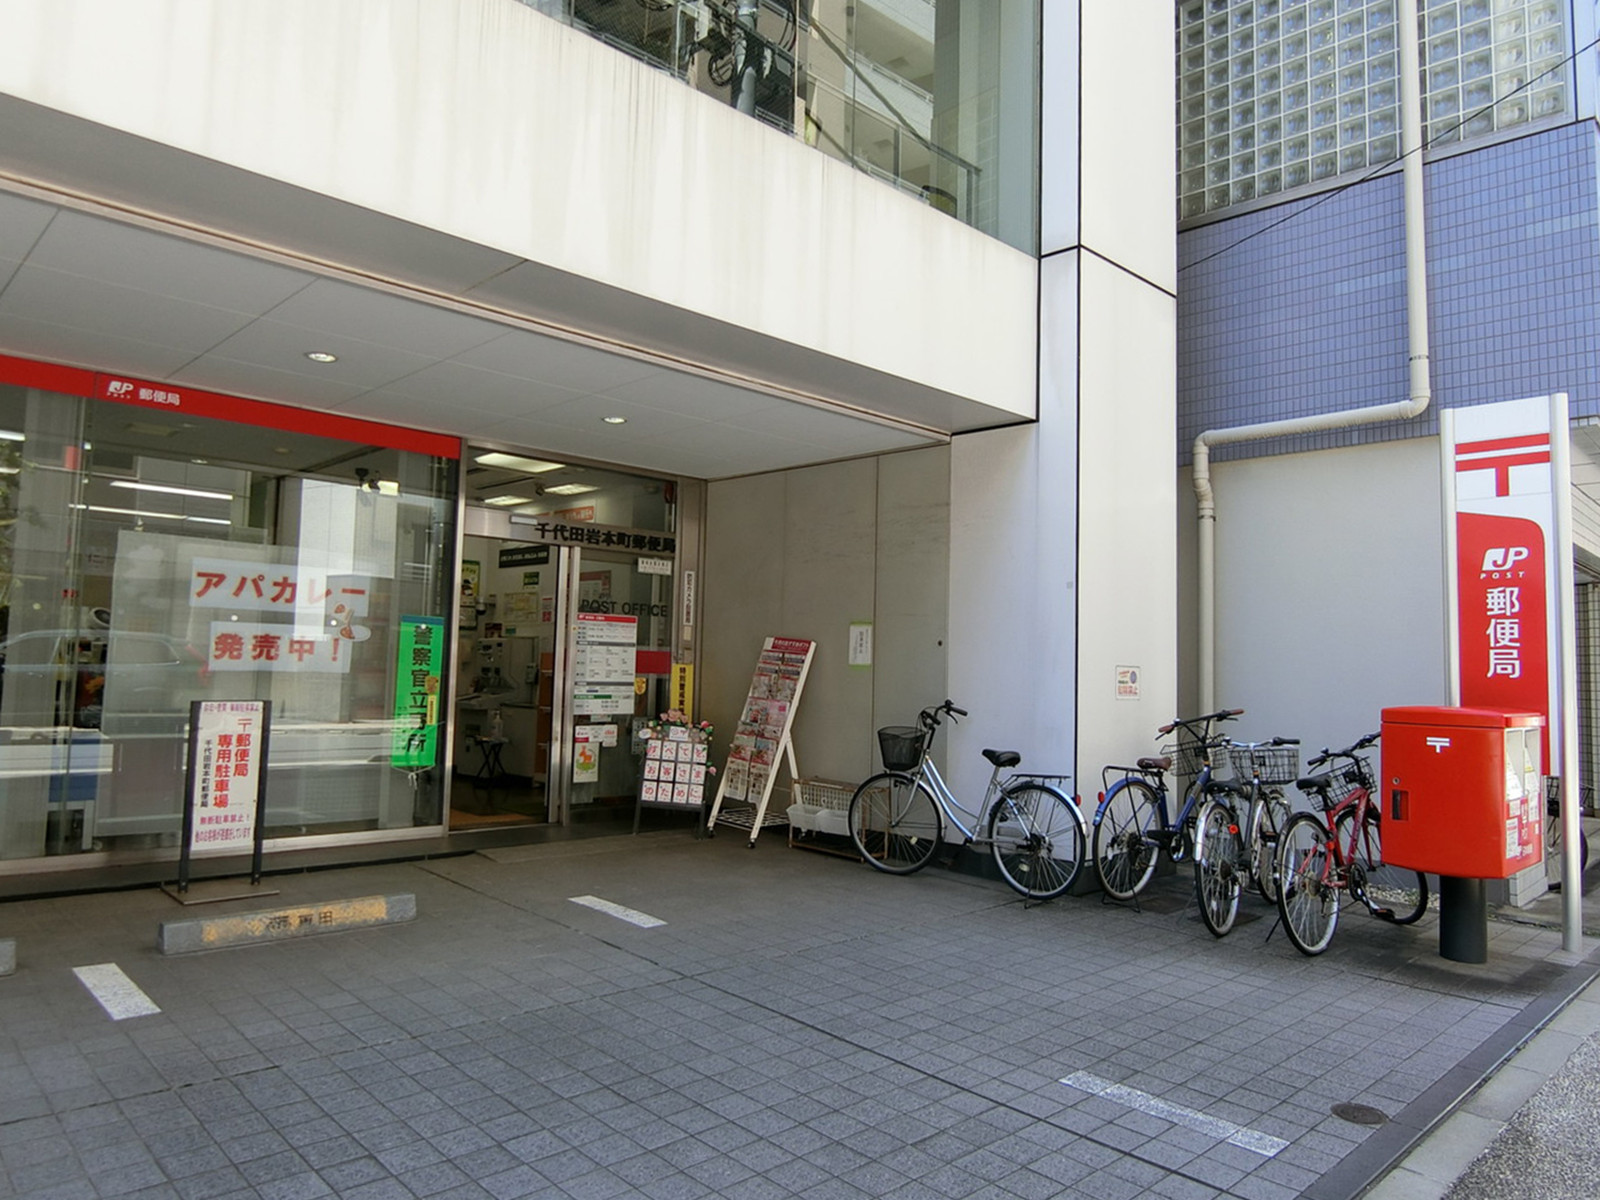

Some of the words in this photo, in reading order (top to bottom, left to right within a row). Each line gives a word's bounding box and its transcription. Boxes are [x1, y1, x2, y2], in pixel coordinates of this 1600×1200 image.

[139, 388, 181, 406] 郵便局
[535, 523, 676, 553] 千代田岩本町郵便局
[1482, 547, 1529, 571] JP
[196, 571, 366, 605] アパカレー
[1480, 571, 1525, 580] POST
[580, 598, 617, 614] POST
[622, 602, 668, 618] OFFICE
[1485, 586, 1522, 679] 郵便局
[233, 733, 252, 777] 郵便局
[213, 733, 234, 809] 専用駐車場
